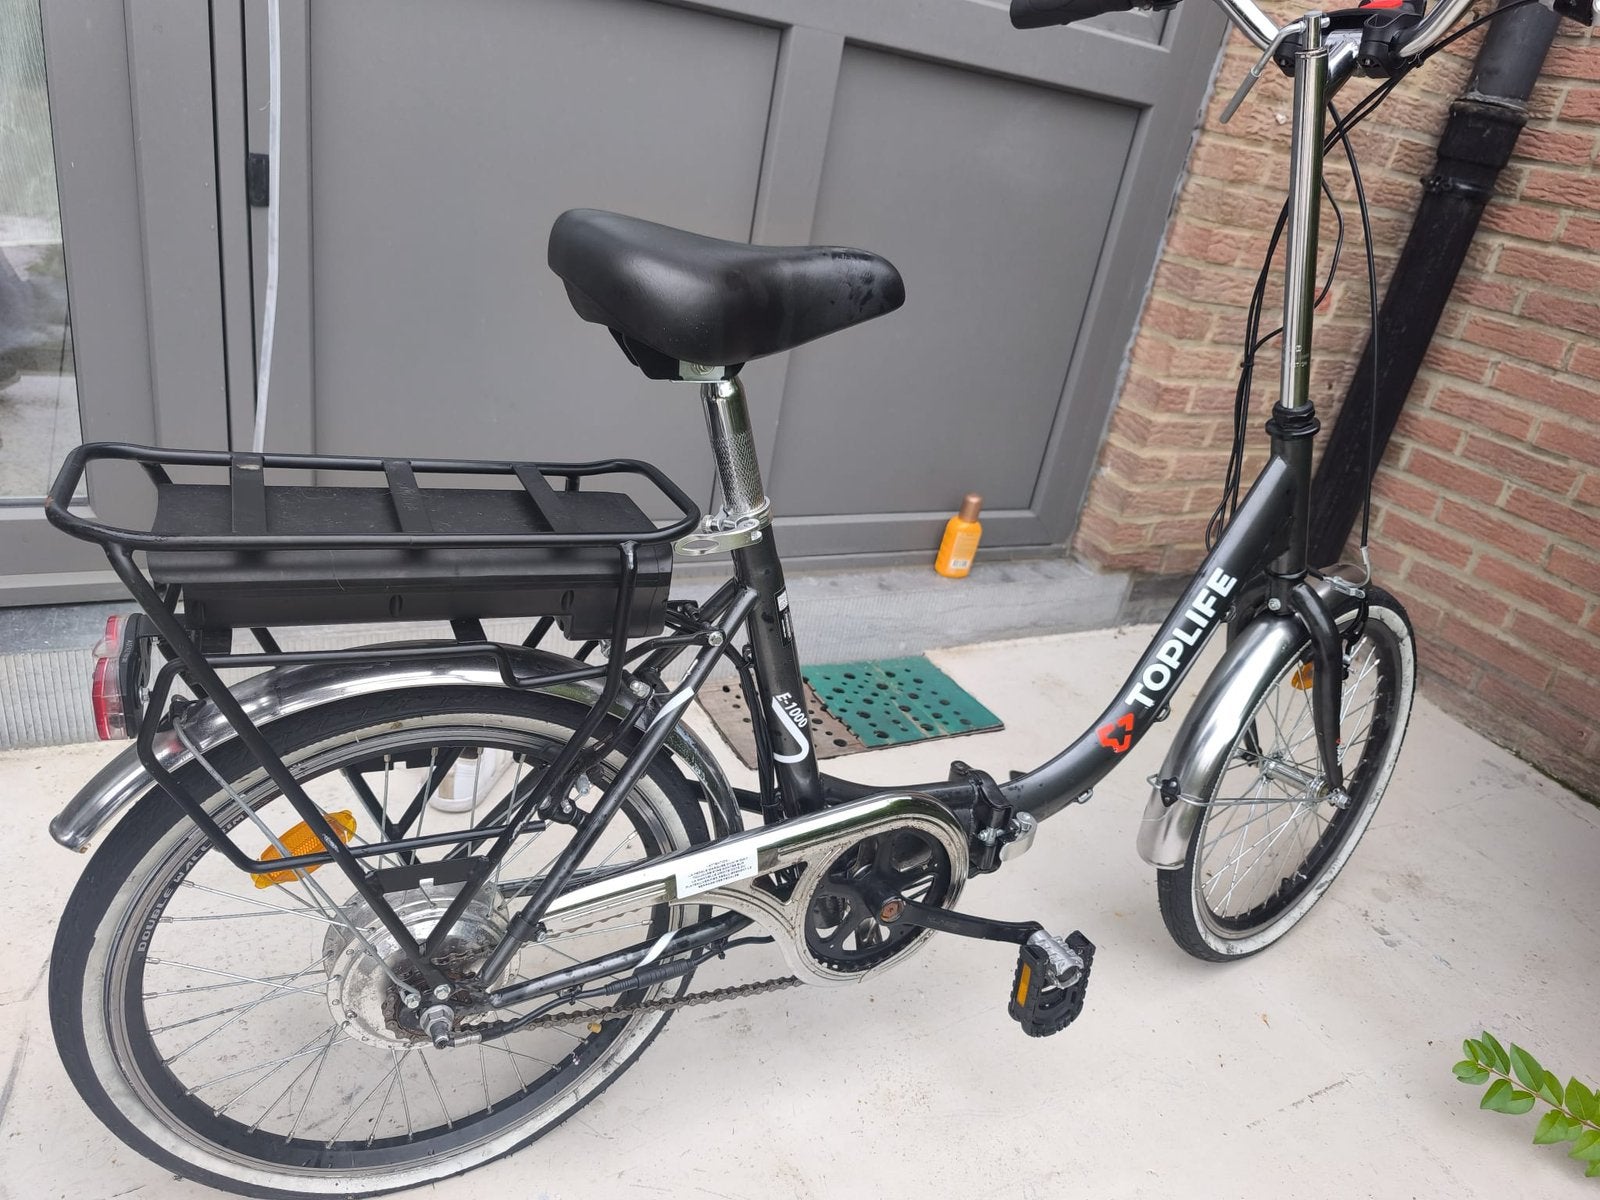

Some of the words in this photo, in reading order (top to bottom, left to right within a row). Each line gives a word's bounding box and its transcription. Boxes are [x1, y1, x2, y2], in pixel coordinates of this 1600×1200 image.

[1125, 567, 1237, 708] TOPLIFE
[776, 692, 808, 728] E-1000
[137, 888, 173, 952] DOUBLE
